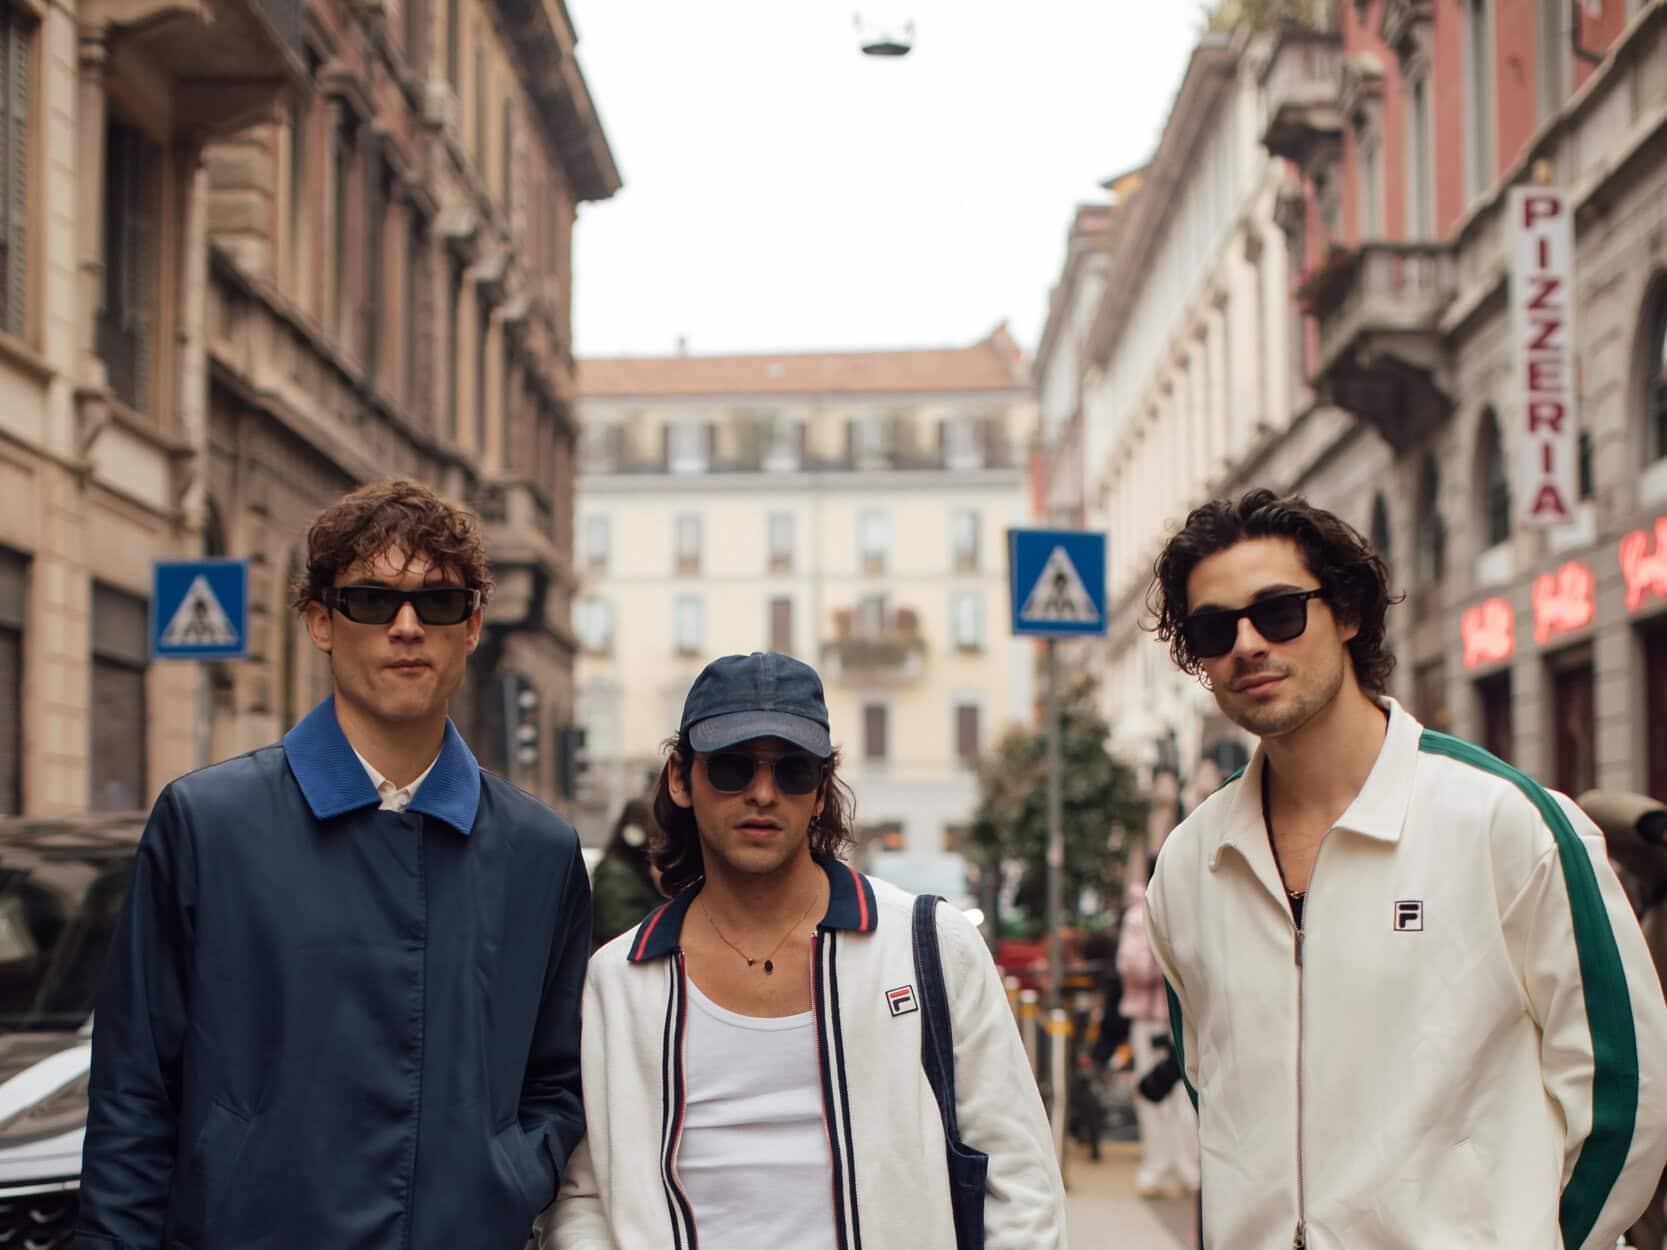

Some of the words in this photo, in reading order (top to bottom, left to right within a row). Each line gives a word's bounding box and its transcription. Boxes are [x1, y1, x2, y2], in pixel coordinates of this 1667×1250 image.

[1523, 196, 1567, 516] PIZZERIA
[1397, 902, 1421, 930] F
[888, 987, 913, 1013] F
